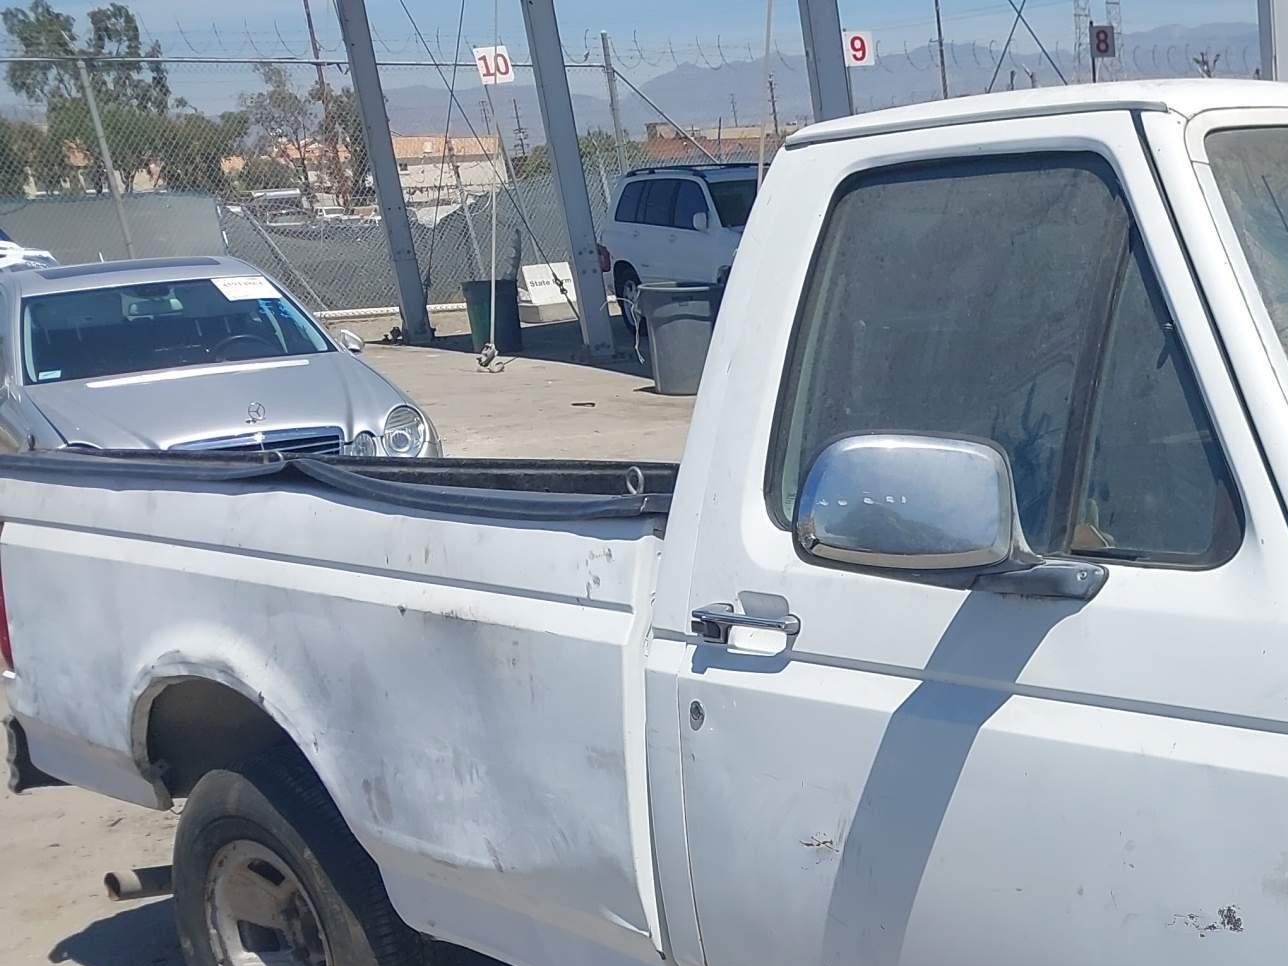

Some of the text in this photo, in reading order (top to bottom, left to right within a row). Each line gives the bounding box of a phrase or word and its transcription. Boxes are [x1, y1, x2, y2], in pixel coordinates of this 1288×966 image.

[850, 36, 866, 61] 9
[1095, 30, 1109, 53] 8
[478, 53, 510, 77] 10
